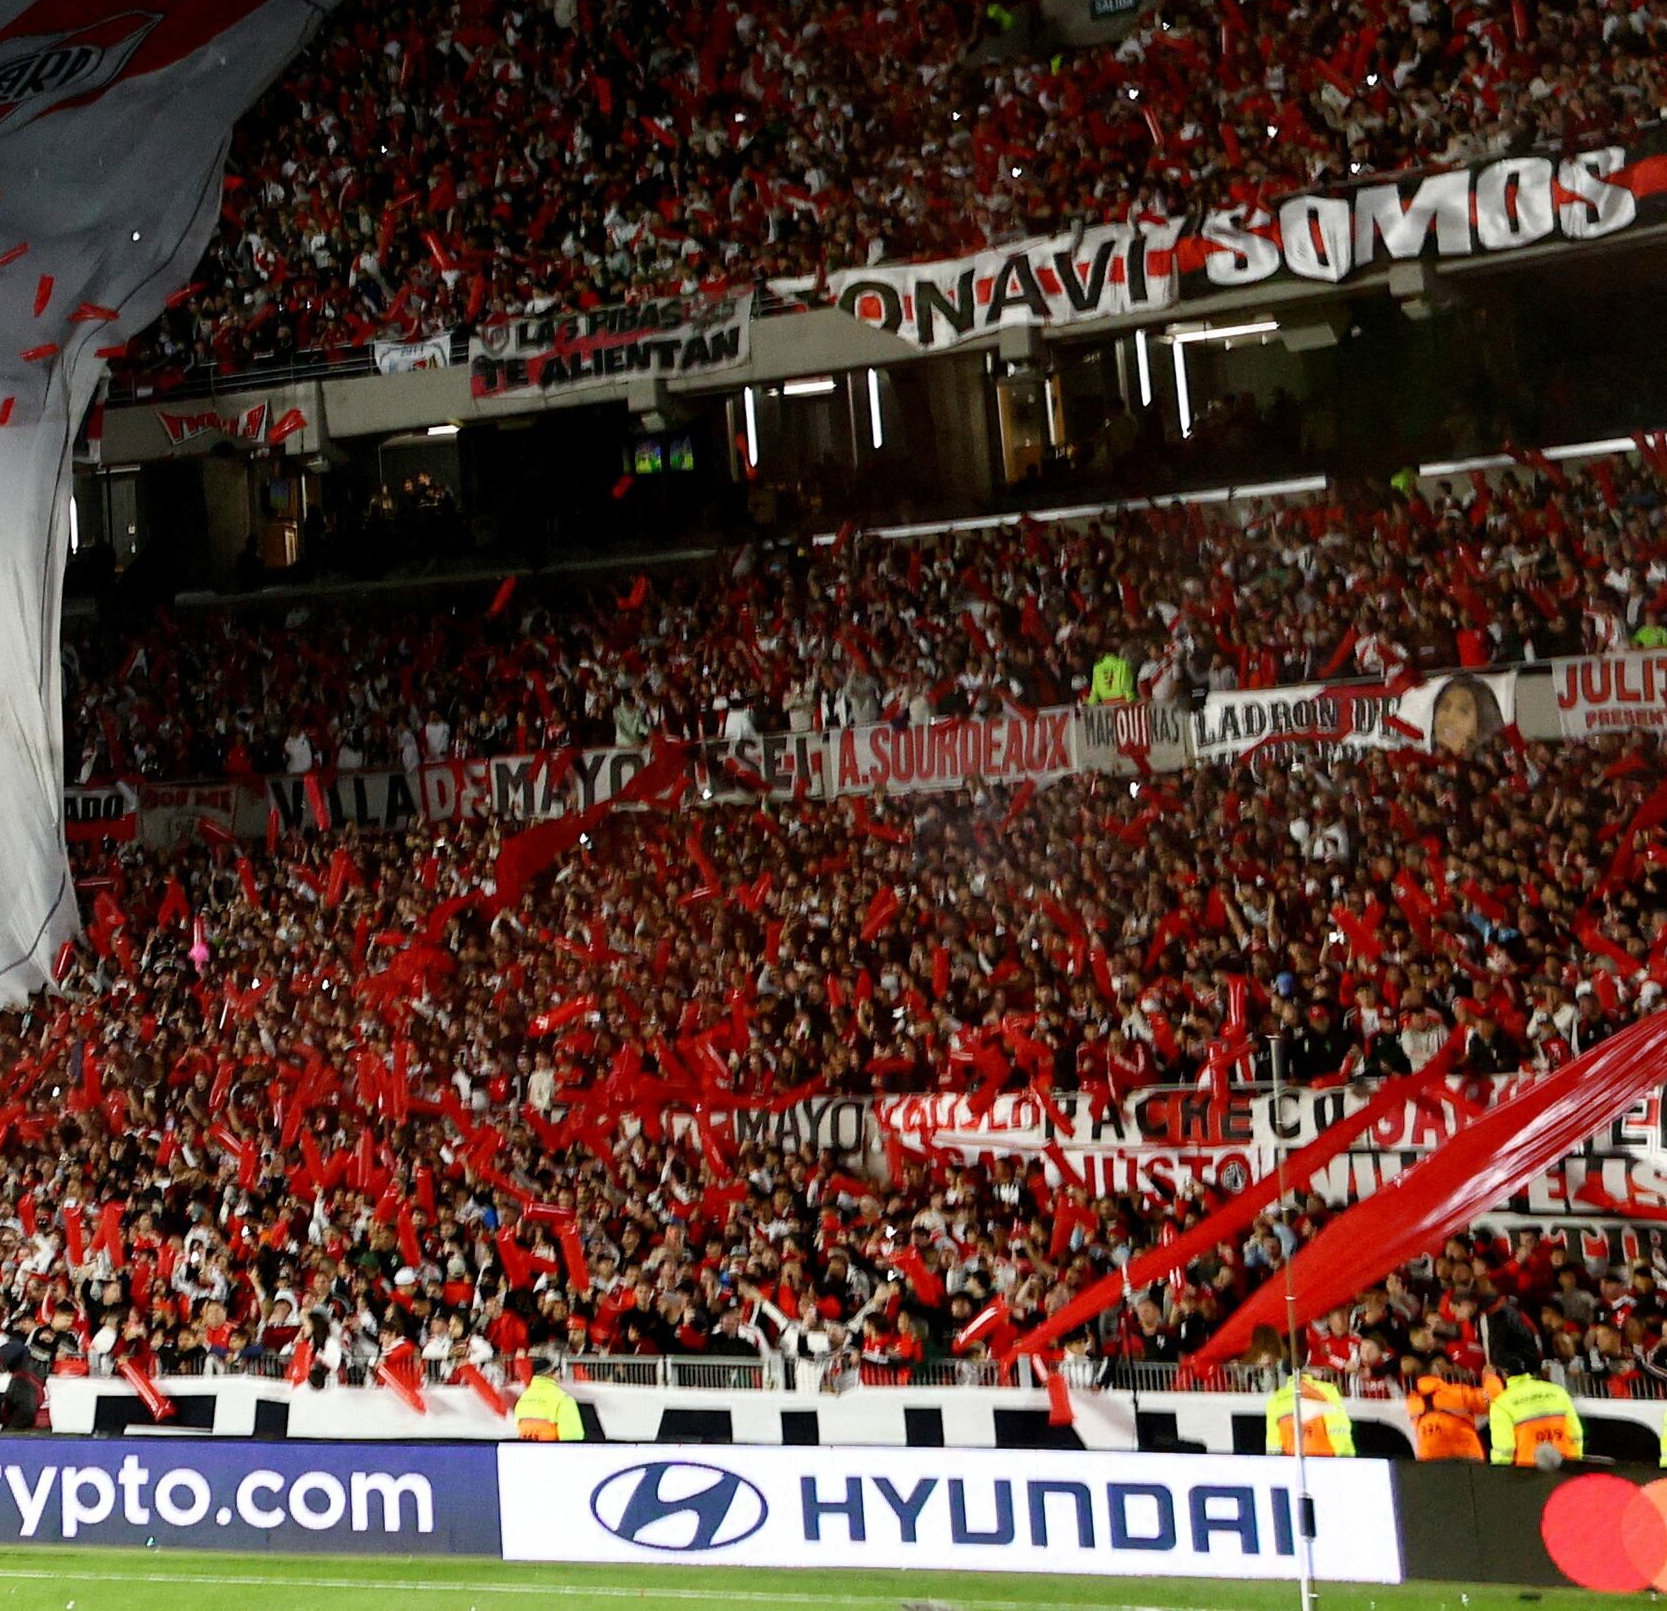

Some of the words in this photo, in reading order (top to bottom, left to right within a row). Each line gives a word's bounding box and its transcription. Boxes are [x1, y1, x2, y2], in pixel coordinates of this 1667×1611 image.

[1206, 146, 1638, 285] SOMOS
[539, 326, 740, 389] ALIENTAN
[801, 1475, 1296, 1557] HYUNDAI
